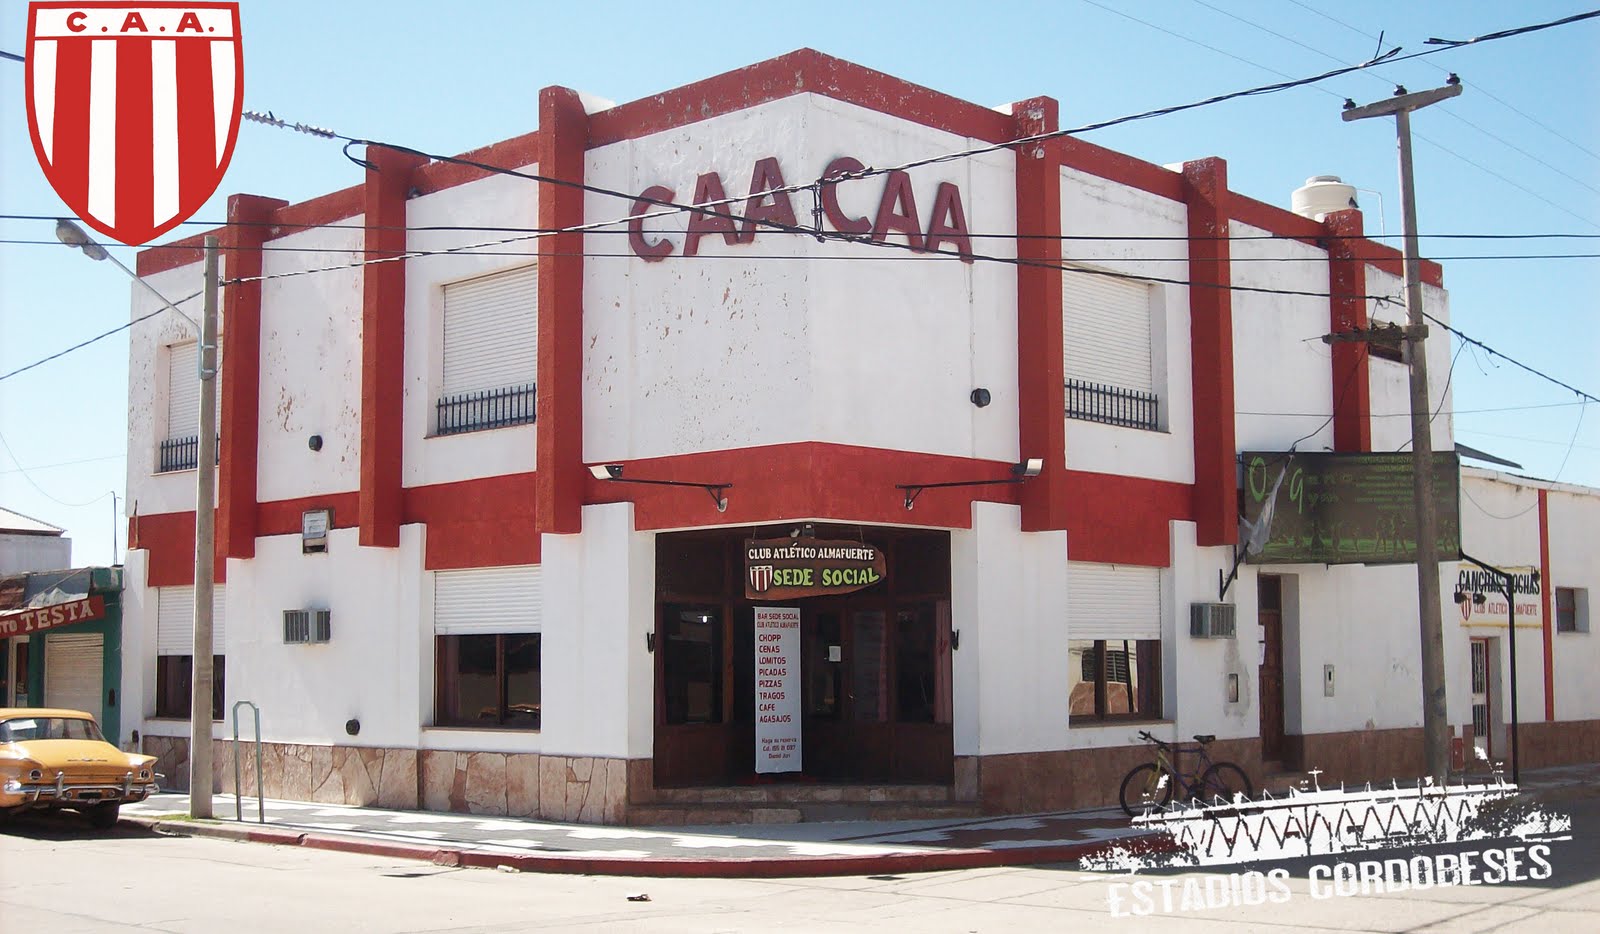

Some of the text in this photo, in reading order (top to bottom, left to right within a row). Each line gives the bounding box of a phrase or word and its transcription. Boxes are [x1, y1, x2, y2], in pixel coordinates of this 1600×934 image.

[628, 156, 974, 265] CAA CAA
[748, 542, 875, 561] CLUB ATLÉTICO ALMAFUERTE
[773, 567, 880, 586] SEDE SOCIAL
[1507, 573, 1540, 596] OCHAS
[0, 600, 94, 635] TO TESTA
[758, 634, 781, 642] CHOPP
[758, 645, 780, 653] CENAS
[758, 657, 786, 665] LOMITOS
[758, 668, 787, 676] PICADAS
[758, 680, 782, 688] PIZZAS
[759, 692, 785, 700] TRAGOS
[759, 703, 775, 711] CAFE
[760, 715, 791, 723] AGASAJOS
